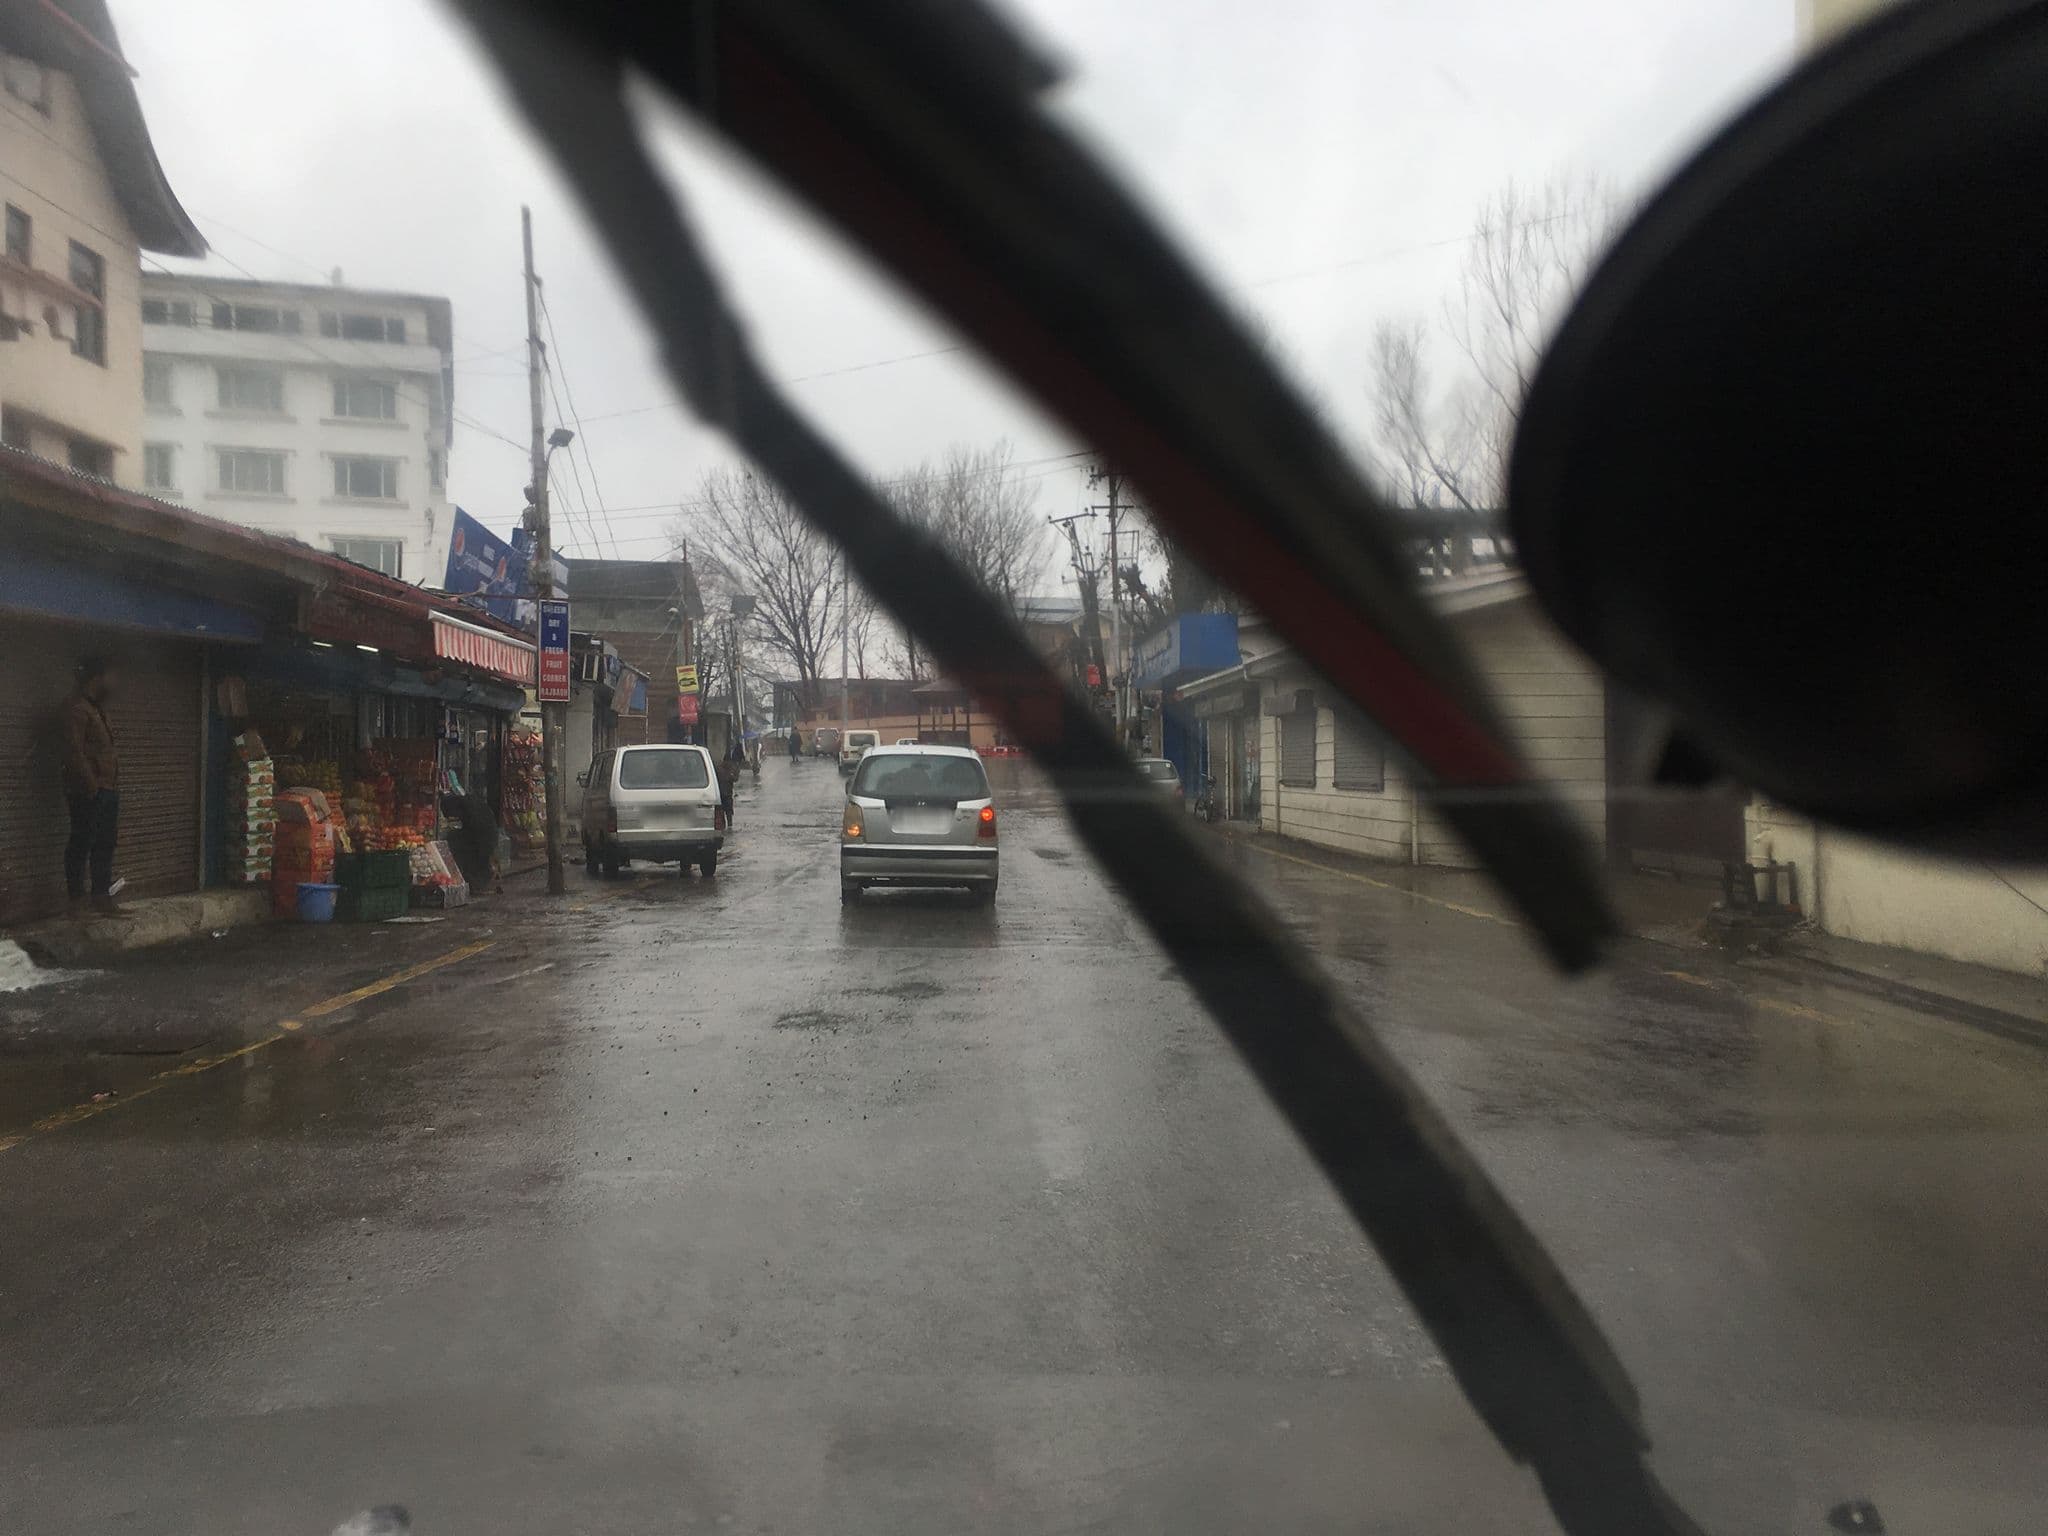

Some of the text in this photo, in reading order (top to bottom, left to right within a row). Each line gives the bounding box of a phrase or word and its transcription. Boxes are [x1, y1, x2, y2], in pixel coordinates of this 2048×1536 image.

[545, 646, 565, 655] FRESH
[546, 660, 562, 669] FRUIT
[543, 674, 566, 682] CORNER
